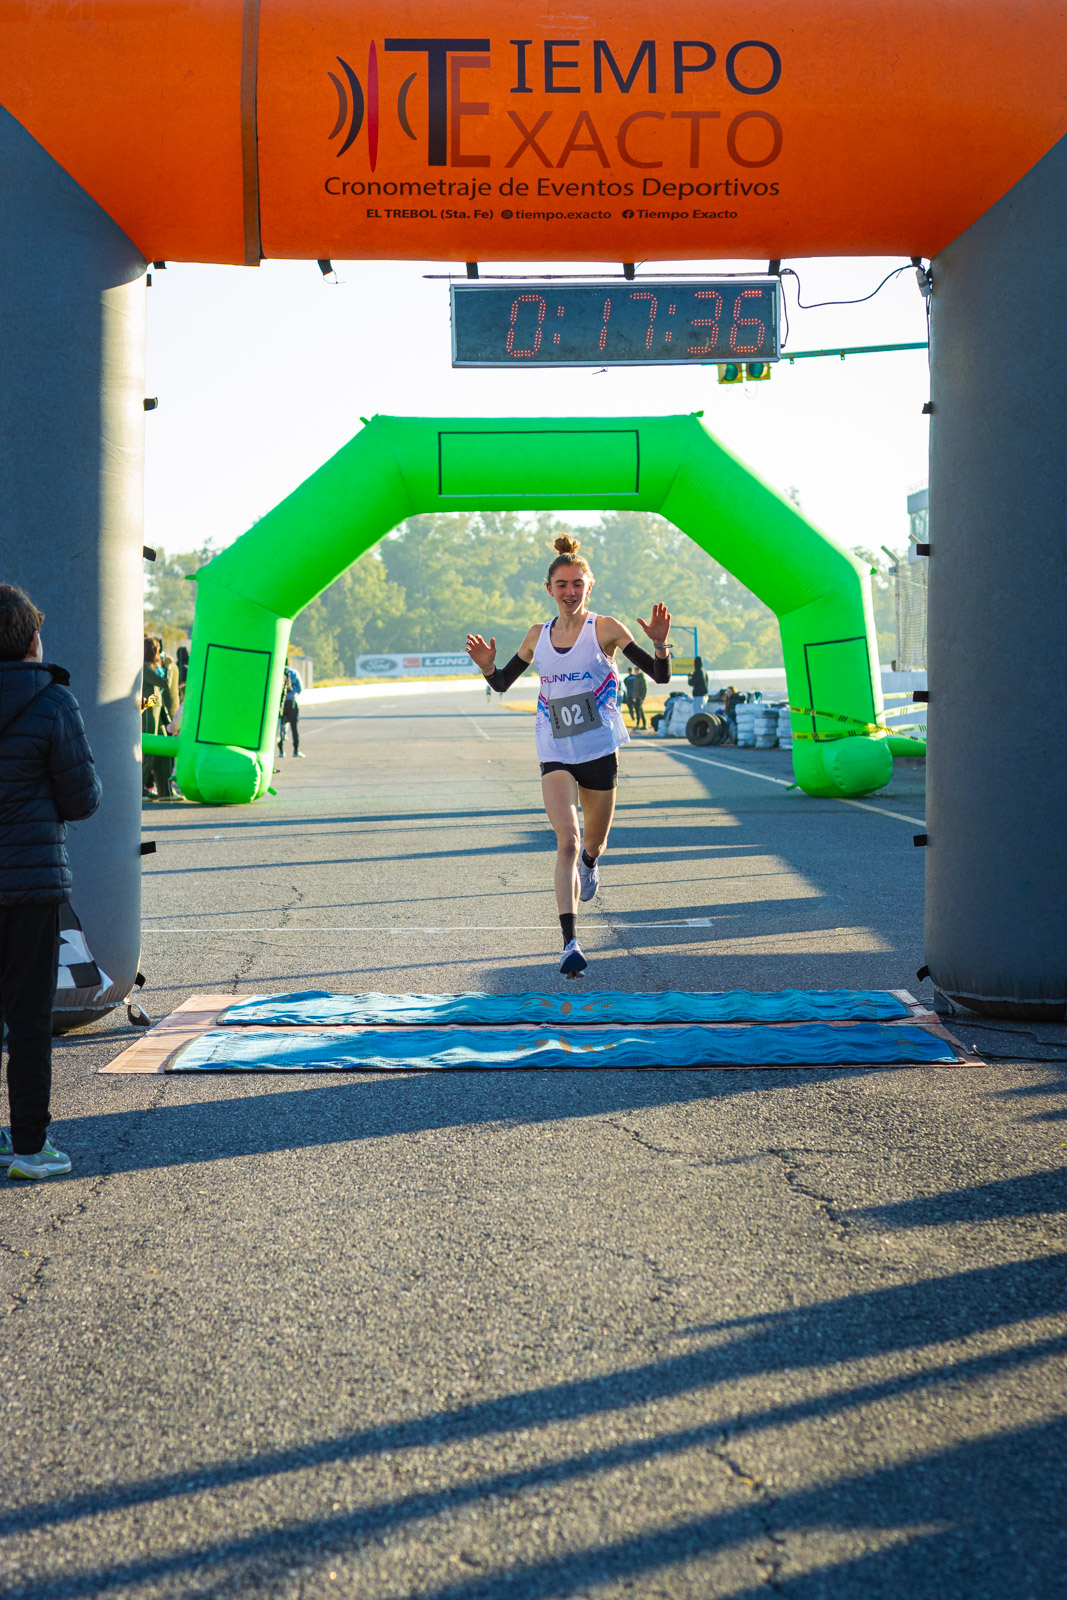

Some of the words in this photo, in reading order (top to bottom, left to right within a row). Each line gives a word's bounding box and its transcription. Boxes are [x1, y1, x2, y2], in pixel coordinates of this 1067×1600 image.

[450, 56, 783, 169] EXACTO
[324, 176, 492, 200] Cronometraje
[499, 177, 529, 196] de
[537, 178, 634, 196] Eventos
[642, 178, 780, 200] Deportivos
[366, 209, 382, 218] EL
[384, 209, 437, 218] TREBOL
[440, 209, 471, 220] (Sta.
[474, 209, 494, 220] Fe)
[516, 209, 612, 221] tiempo.exacto
[636, 209, 689, 221] Tiempo
[692, 209, 738, 219] Exacto
[506, 290, 764, 357] 0:17:36
[424, 657, 469, 666] LONG
[540, 671, 593, 685] RUNNEA
[561, 704, 584, 727] 02
